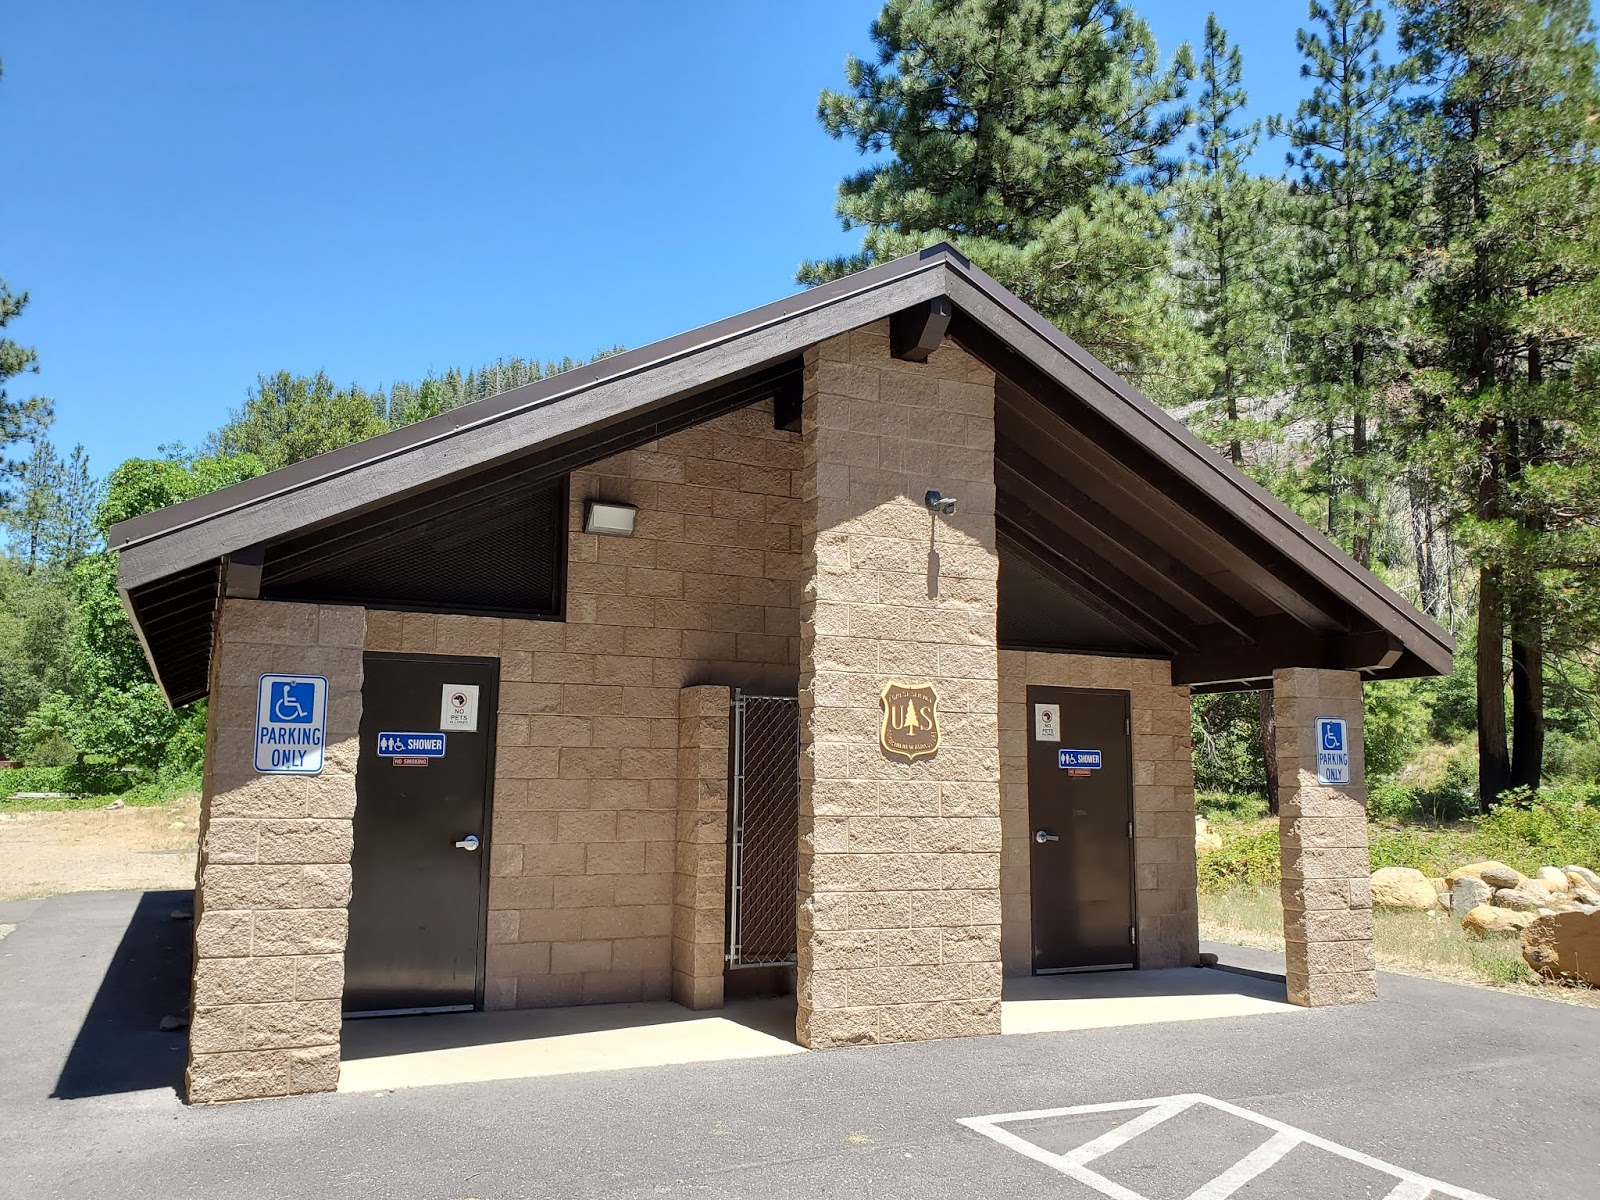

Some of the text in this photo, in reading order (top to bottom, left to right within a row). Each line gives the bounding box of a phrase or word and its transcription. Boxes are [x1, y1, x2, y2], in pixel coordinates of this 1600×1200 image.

[891, 704, 933, 731] U S
[260, 726, 322, 746] PARKING
[407, 738, 443, 750] SHOWER
[271, 748, 308, 768] ONLY
[1077, 754, 1100, 764] SHOWER
[1319, 752, 1348, 766] PARKING
[1325, 767, 1343, 781] ONLY
